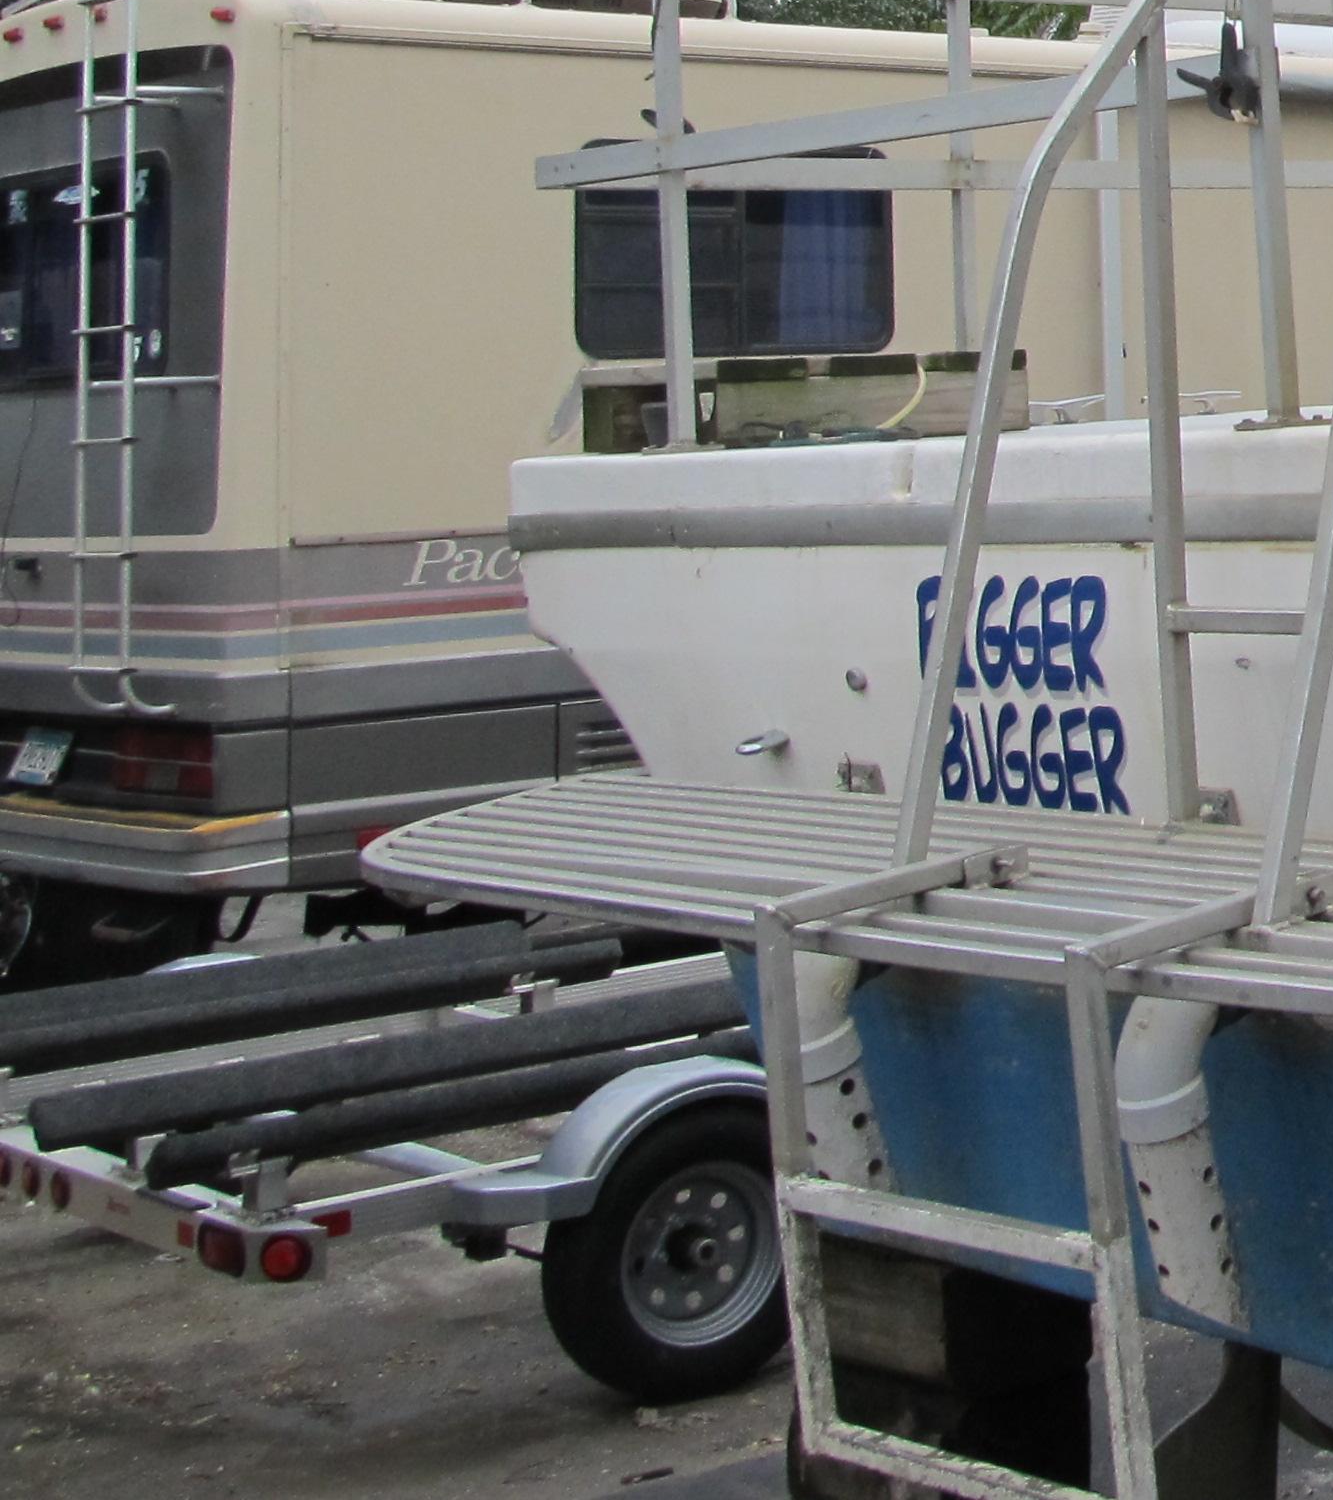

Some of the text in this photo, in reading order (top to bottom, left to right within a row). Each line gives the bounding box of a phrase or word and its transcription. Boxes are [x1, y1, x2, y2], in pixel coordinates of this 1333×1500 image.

[402, 538, 522, 587] Pac
[915, 574, 1108, 694] GGER
[940, 702, 1131, 815] BUGGER
